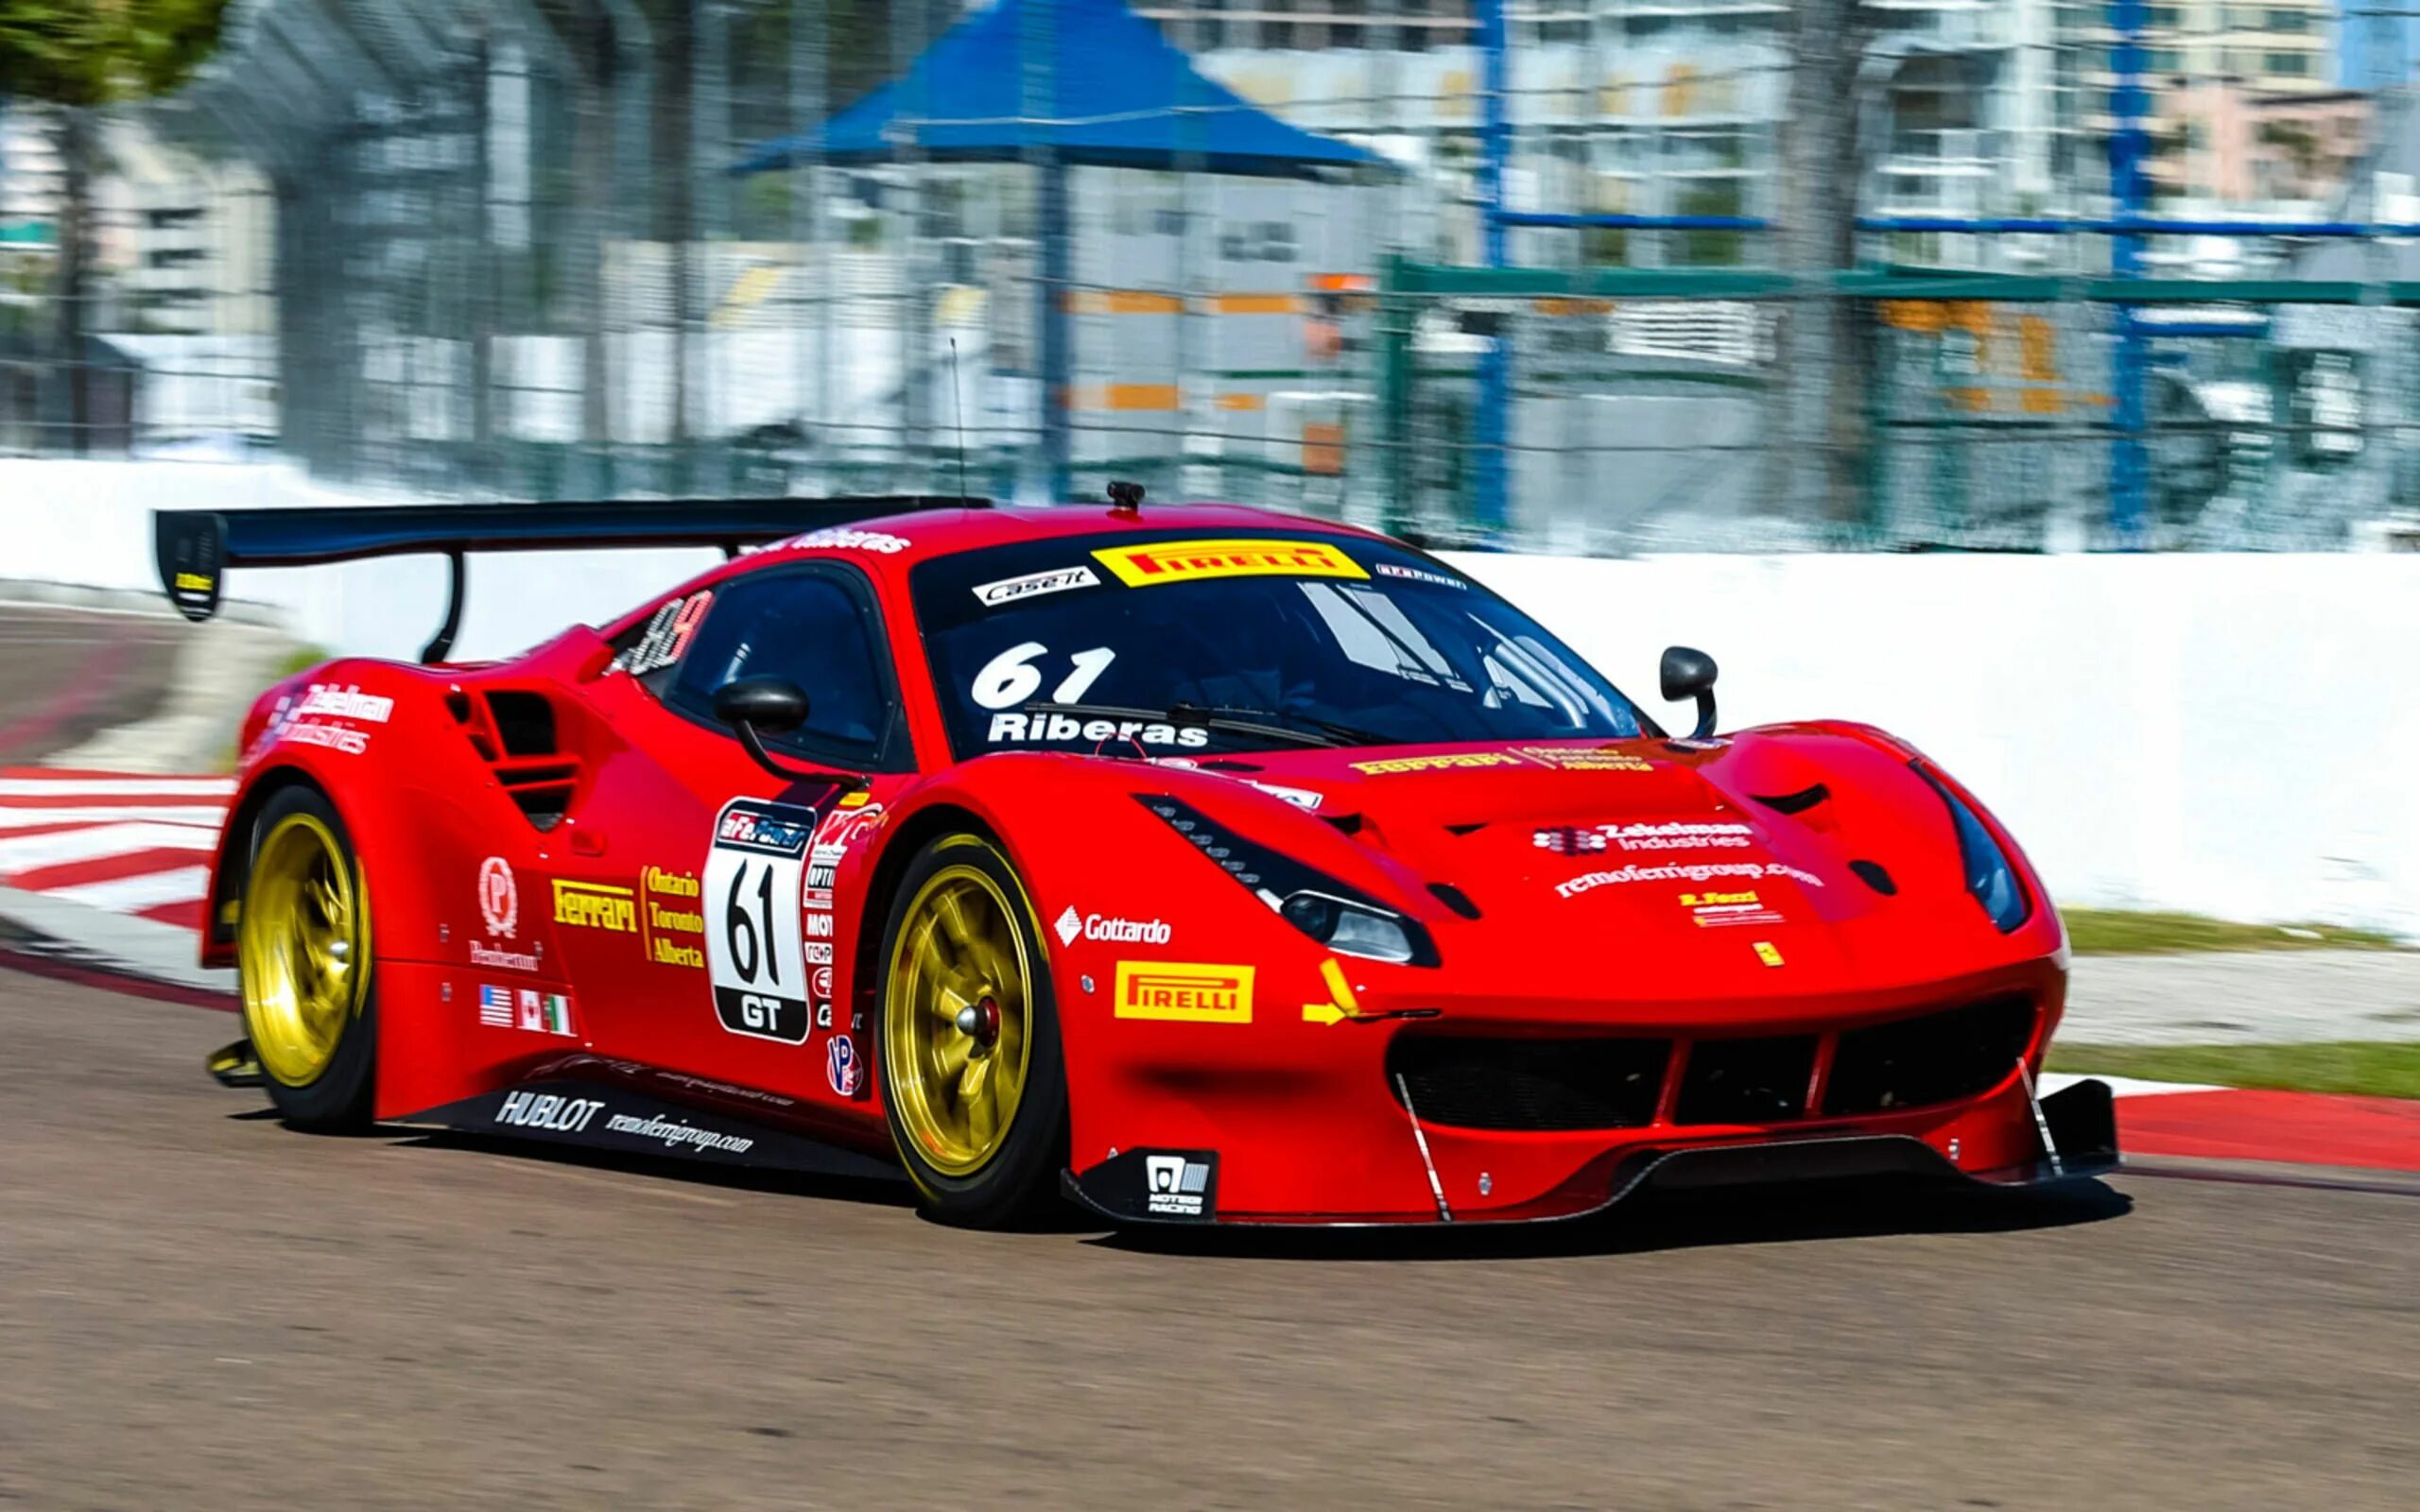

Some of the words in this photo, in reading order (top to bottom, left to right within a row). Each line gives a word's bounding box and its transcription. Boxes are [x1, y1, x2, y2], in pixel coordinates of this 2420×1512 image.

[1127, 547, 1338, 576] PIRELLI
[971, 642, 1116, 710] 61
[988, 713, 1209, 747] Riberas
[1349, 752, 1522, 775] Ferrari
[1595, 821, 1753, 838] Zekelman
[1617, 833, 1751, 850] Industries
[648, 866, 700, 898] Ontario
[551, 878, 638, 933] Ferrari
[648, 901, 704, 934] Toronto
[727, 858, 780, 986] 61
[1084, 913, 1172, 944] Gottardo
[654, 936, 704, 969] Alberta
[1127, 973, 1239, 1011] PIRELLI
[741, 994, 782, 1032] GT
[495, 1091, 606, 1132] HUBLOT
[605, 1113, 754, 1154] remoferrigroup.com
